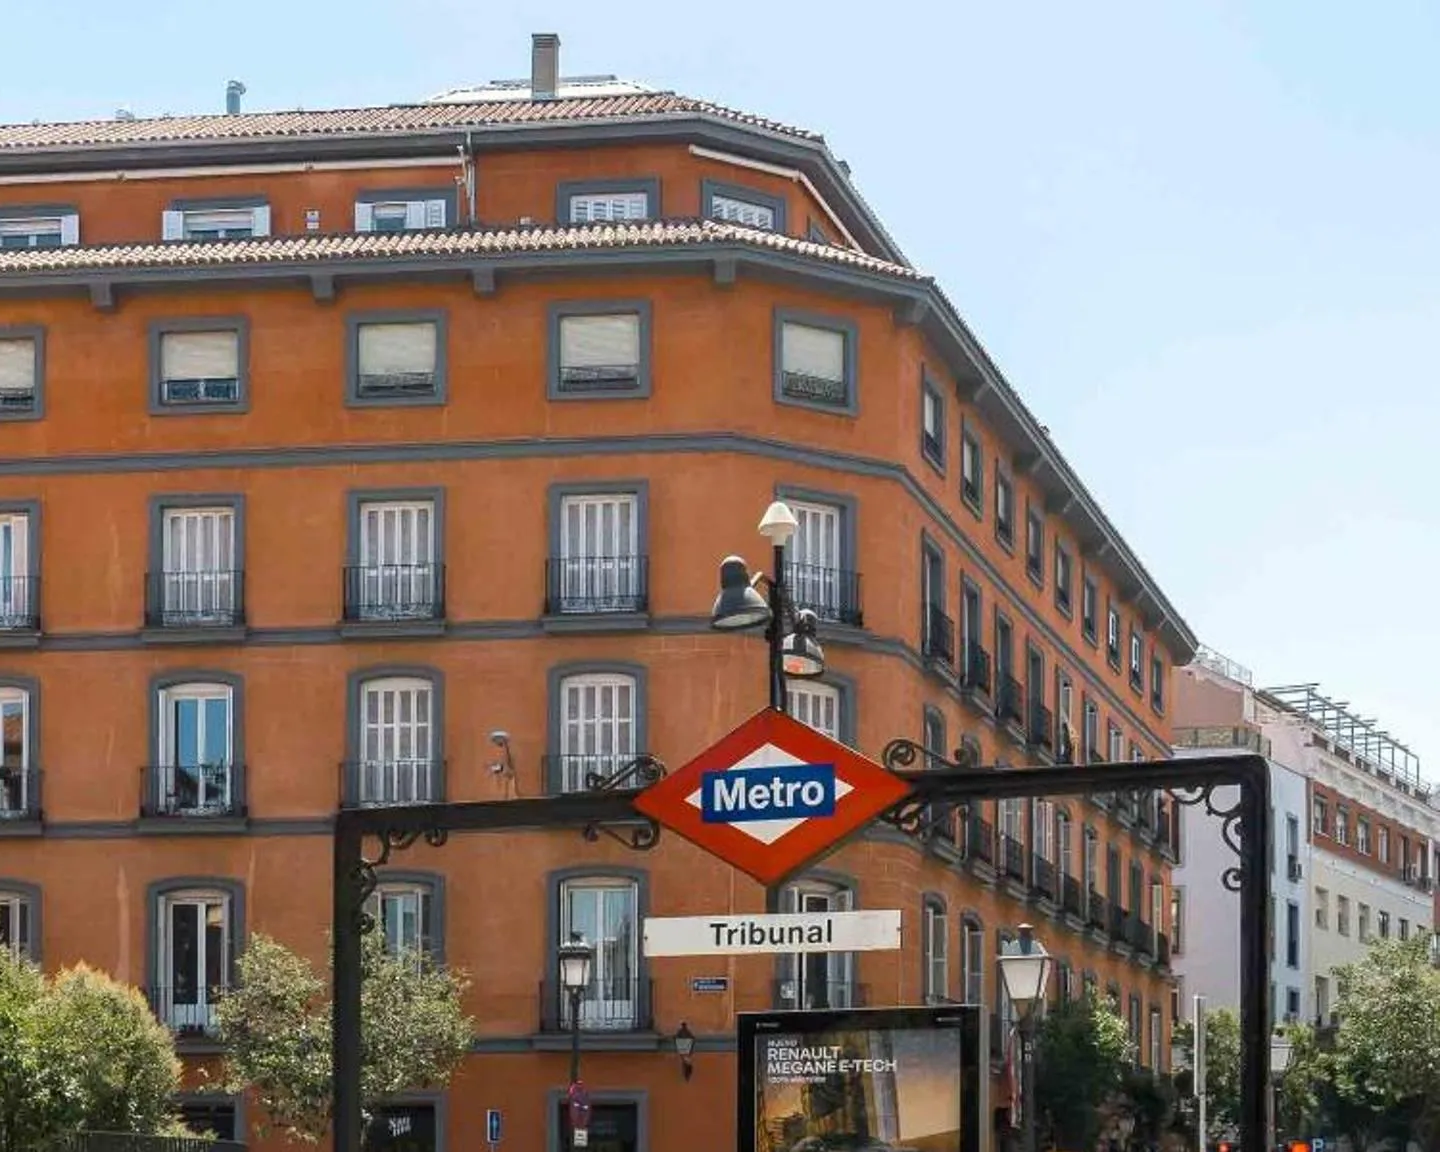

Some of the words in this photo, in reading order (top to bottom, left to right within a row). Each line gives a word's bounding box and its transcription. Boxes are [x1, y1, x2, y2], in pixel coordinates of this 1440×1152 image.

[713, 776, 826, 812] Metro
[710, 919, 833, 946] Tribunal
[767, 1045, 842, 1061] RENAULT
[767, 1061, 837, 1075] MEGANE
[838, 1059, 897, 1073] E-TECH
